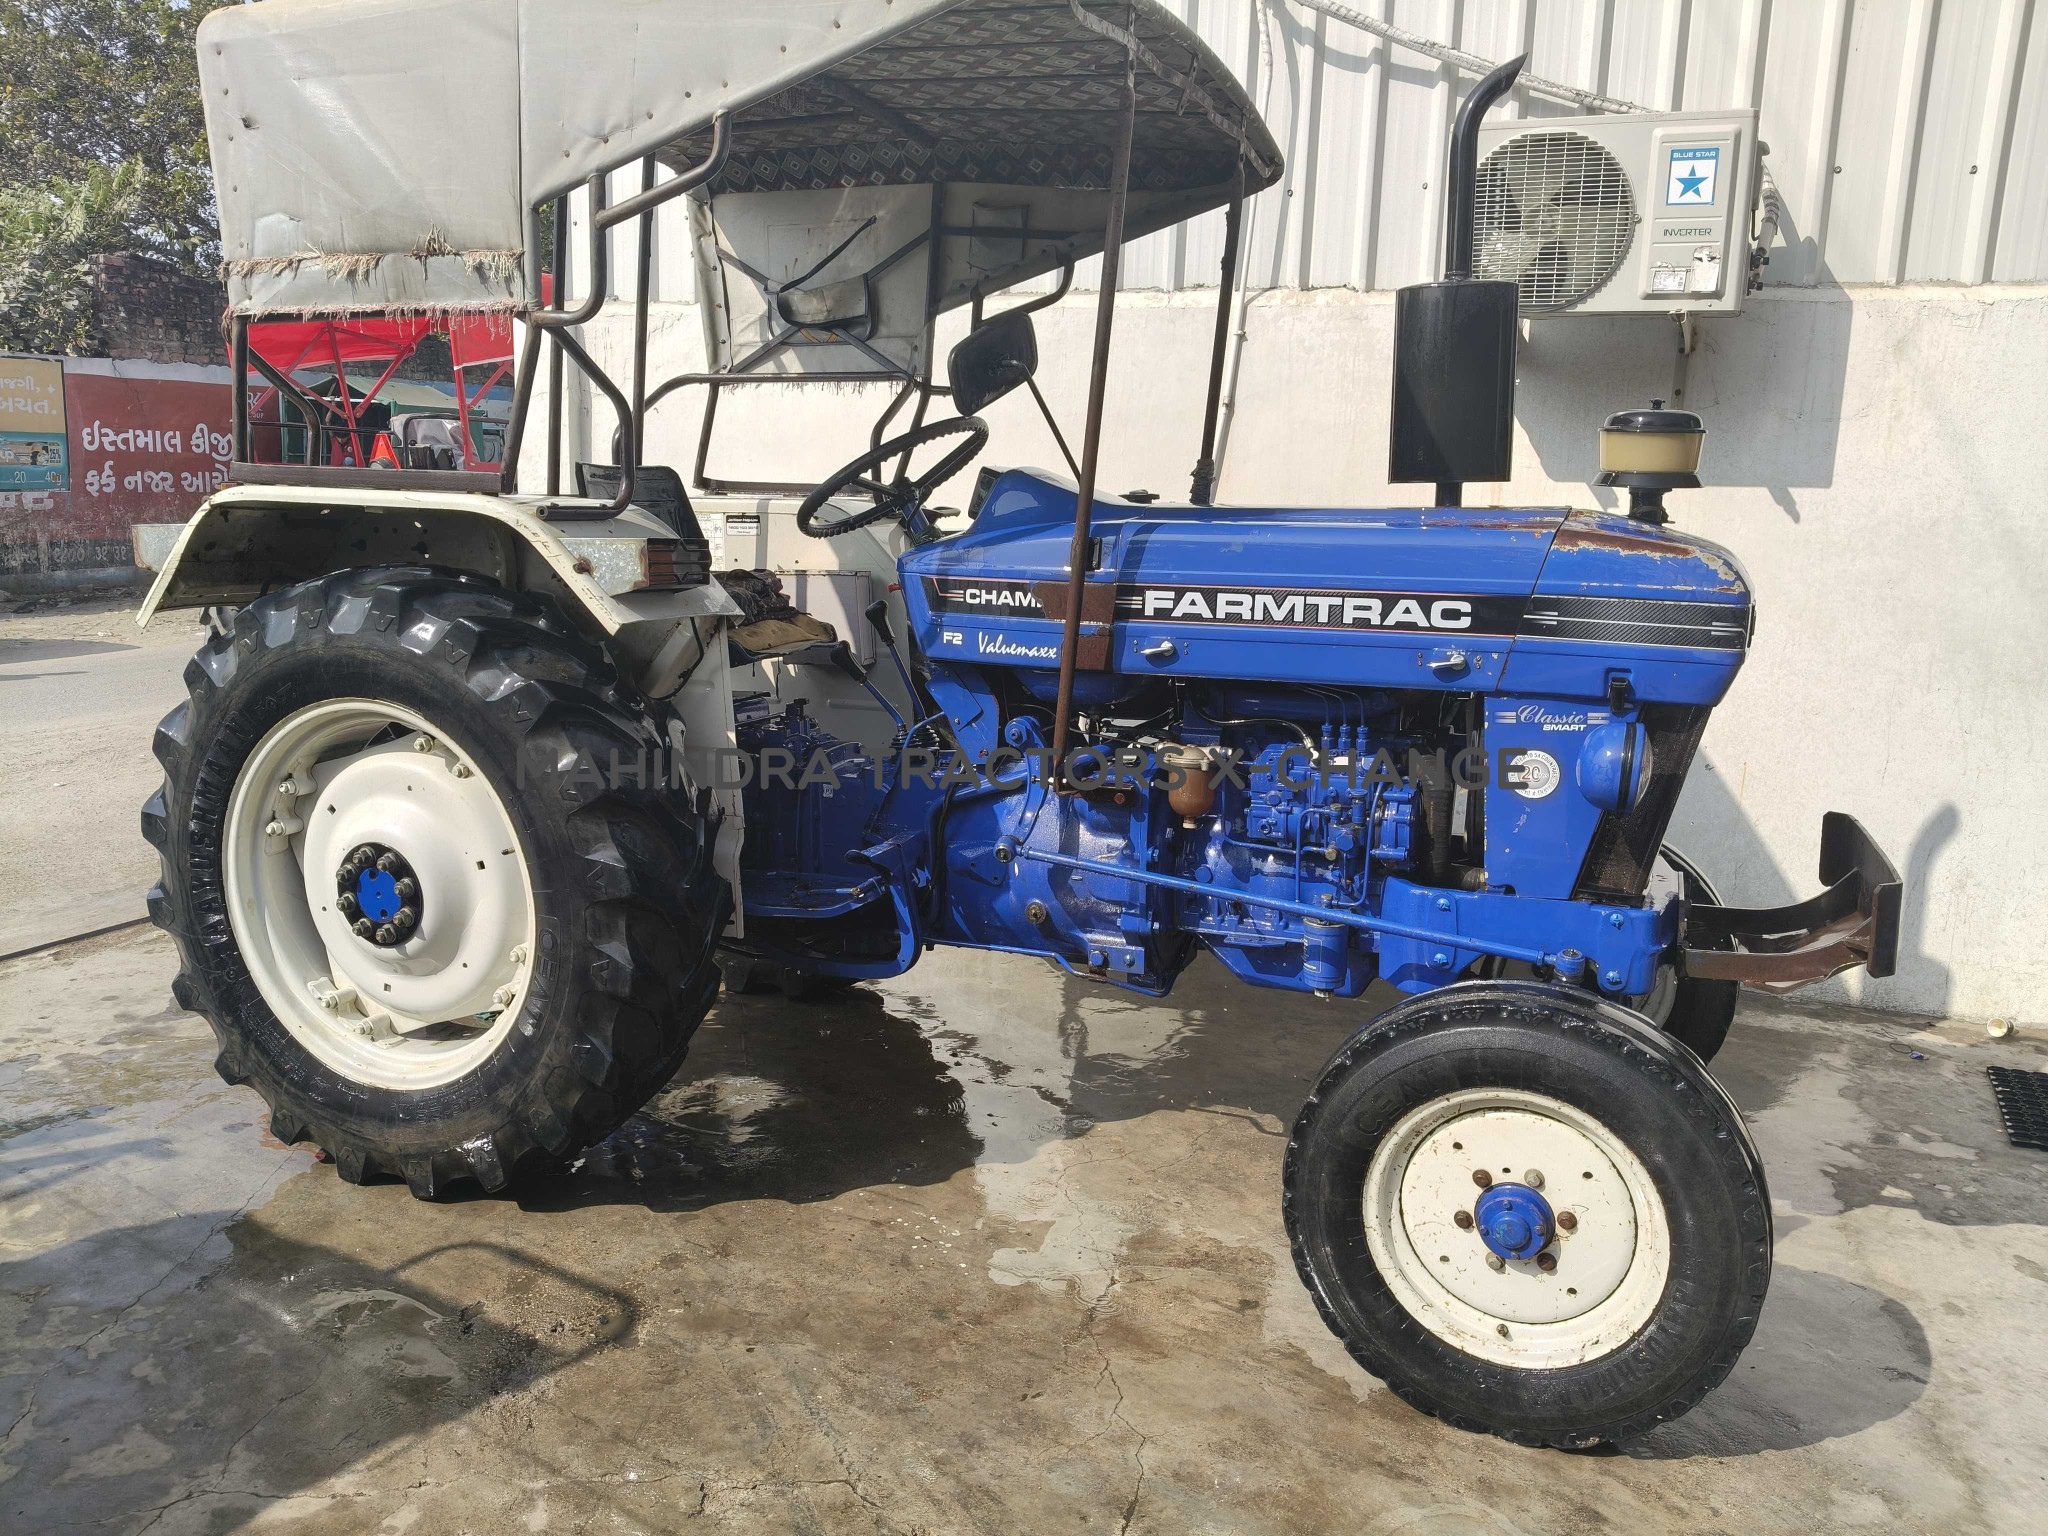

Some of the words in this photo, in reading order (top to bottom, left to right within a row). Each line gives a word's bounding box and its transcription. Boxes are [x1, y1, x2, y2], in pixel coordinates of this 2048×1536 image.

[1663, 228, 1712, 237] INVERTER
[14, 471, 26, 484] 20
[123, 470, 175, 494] નજર
[965, 588, 1043, 608] CHAM
[1144, 590, 1472, 629] FARMTRAC
[943, 631, 963, 646] F2
[978, 631, 1058, 660] Valuemaxx
[1517, 704, 1587, 724] Classic
[1542, 724, 1588, 732] SMART
[1520, 764, 1541, 782] 20
